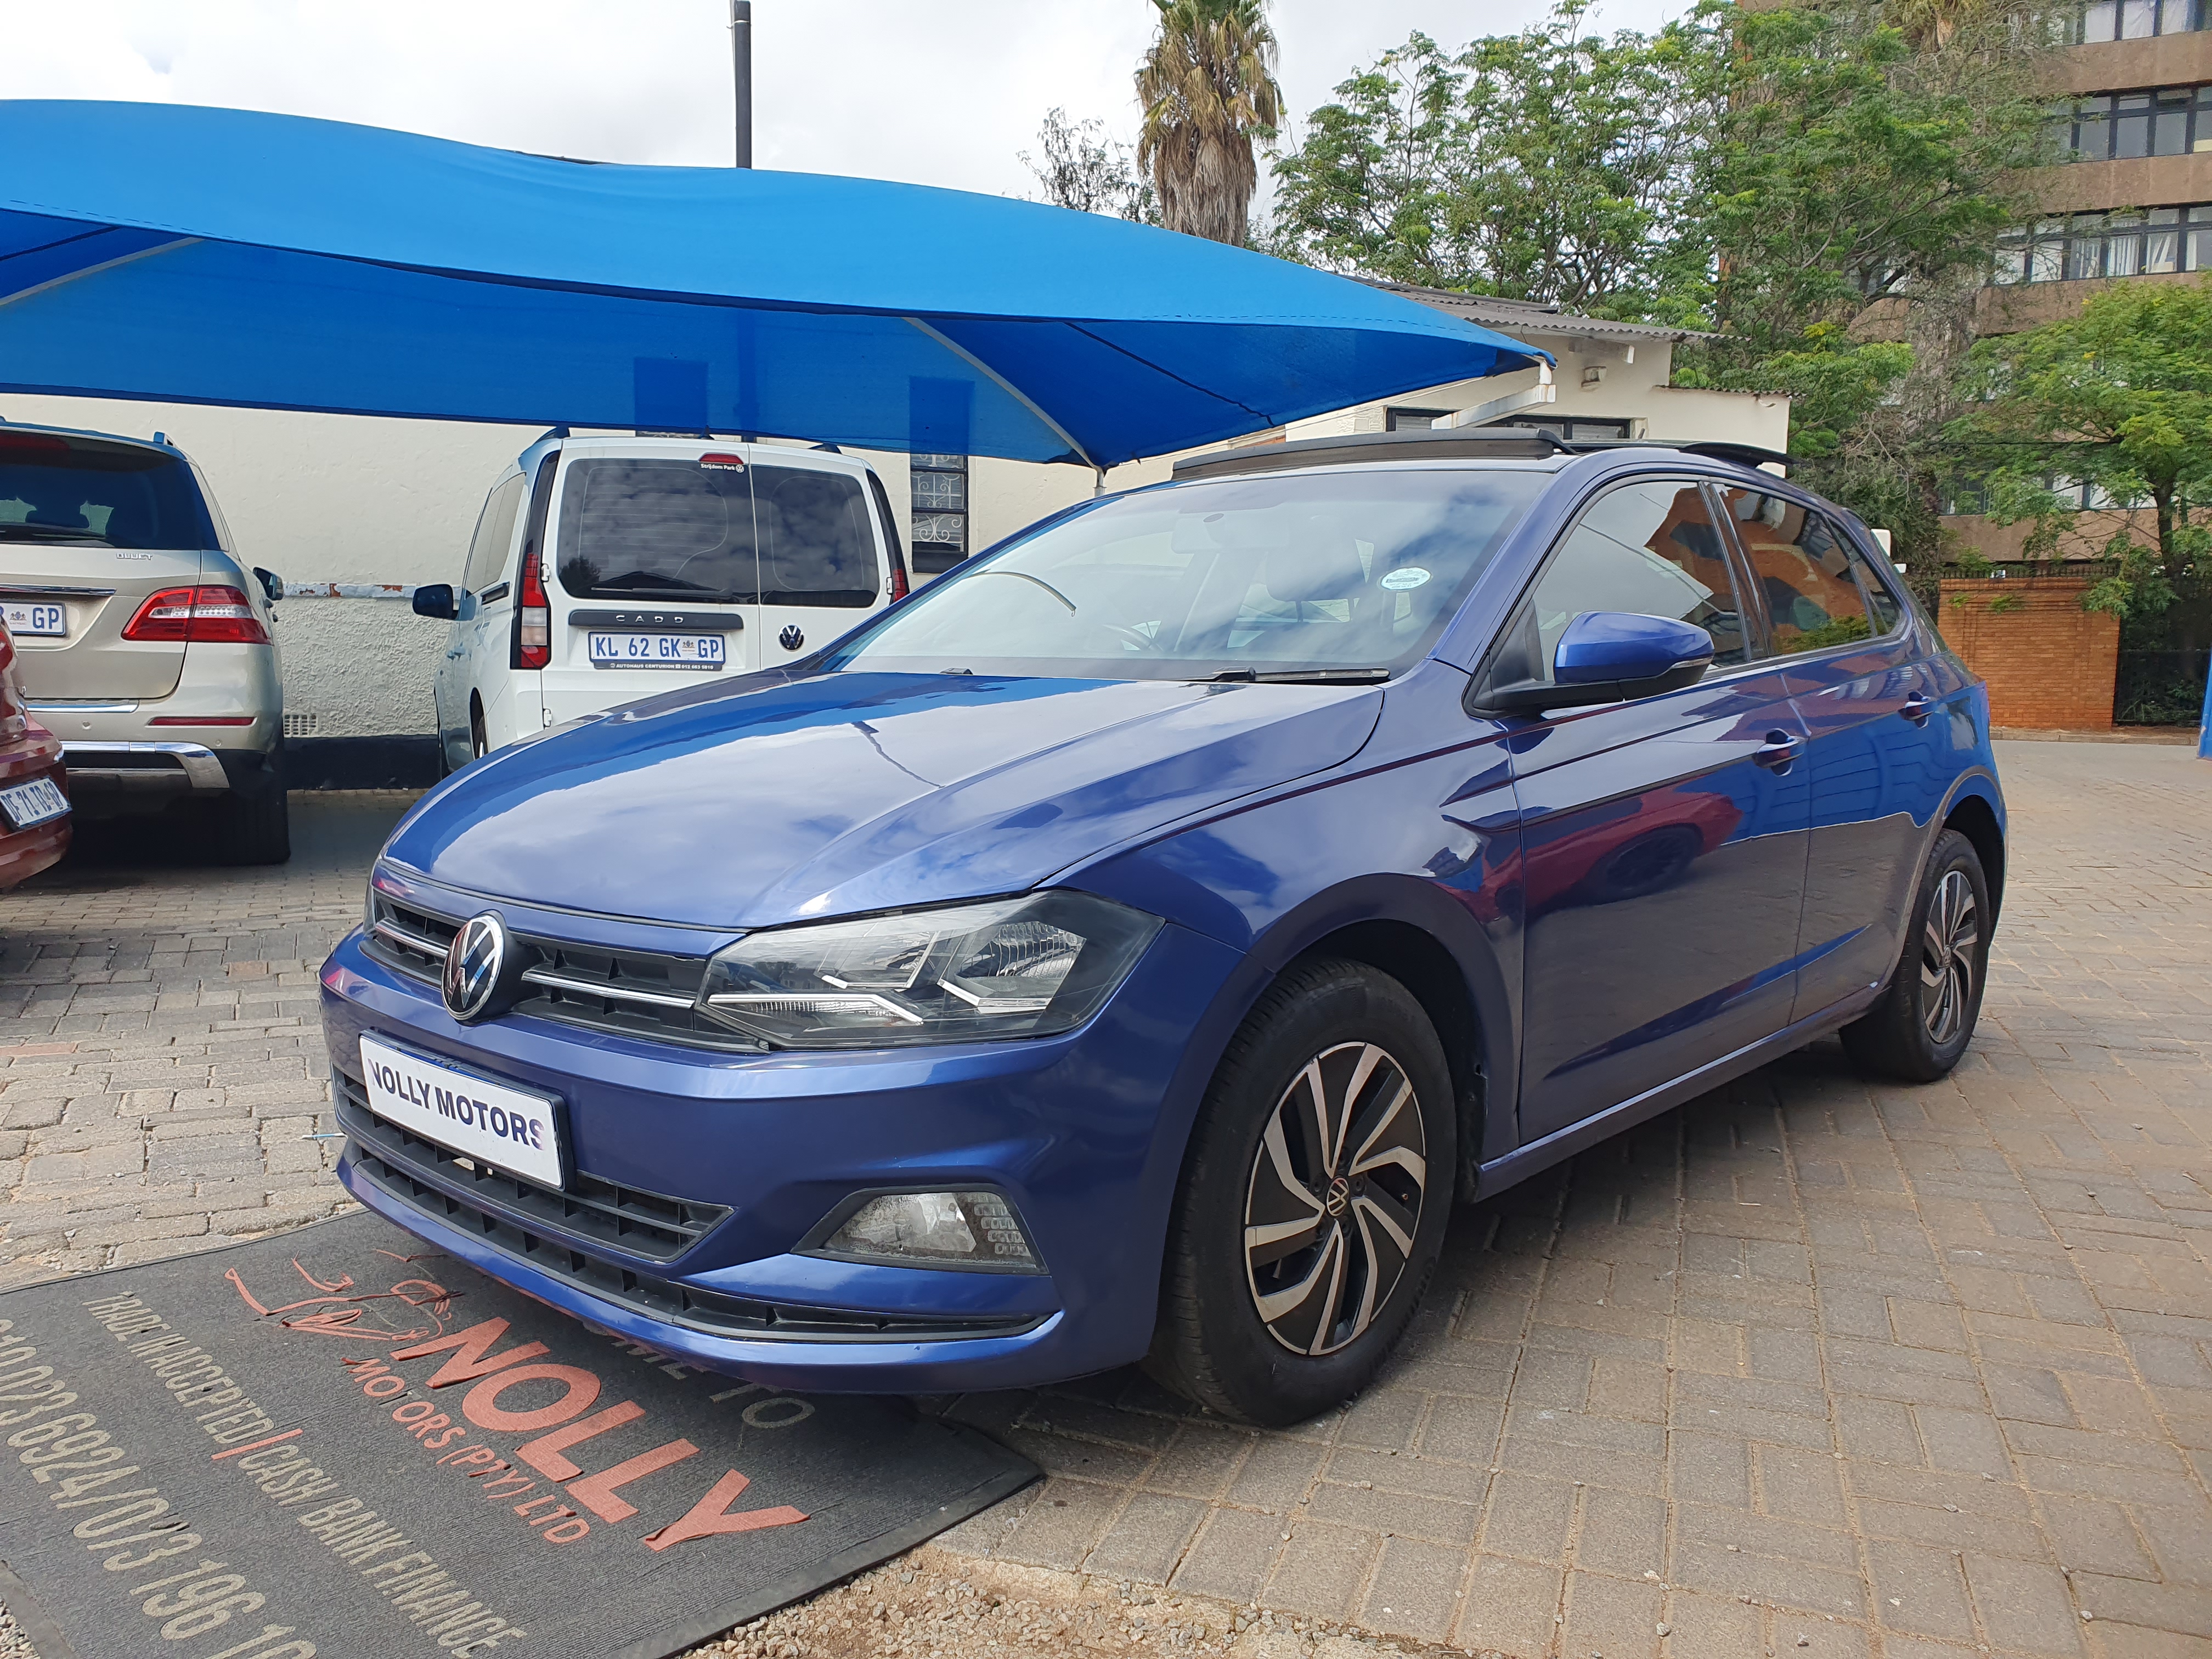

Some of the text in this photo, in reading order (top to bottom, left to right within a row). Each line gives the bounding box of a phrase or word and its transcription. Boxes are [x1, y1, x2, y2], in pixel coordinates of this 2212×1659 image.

[32, 607, 59, 629] GP
[596, 637, 719, 658] KL 62 GK GP
[368, 1058, 545, 1151] NOLLY MOTORS
[82, 1290, 275, 1444] TRADE IN ACCEPTED
[390, 1317, 810, 1551] NOLLY
[341, 1357, 591, 1543] MOTORS (PTY) LTD
[297, 1497, 413, 1566] BANK
[361, 1550, 528, 1659] FINANCE
